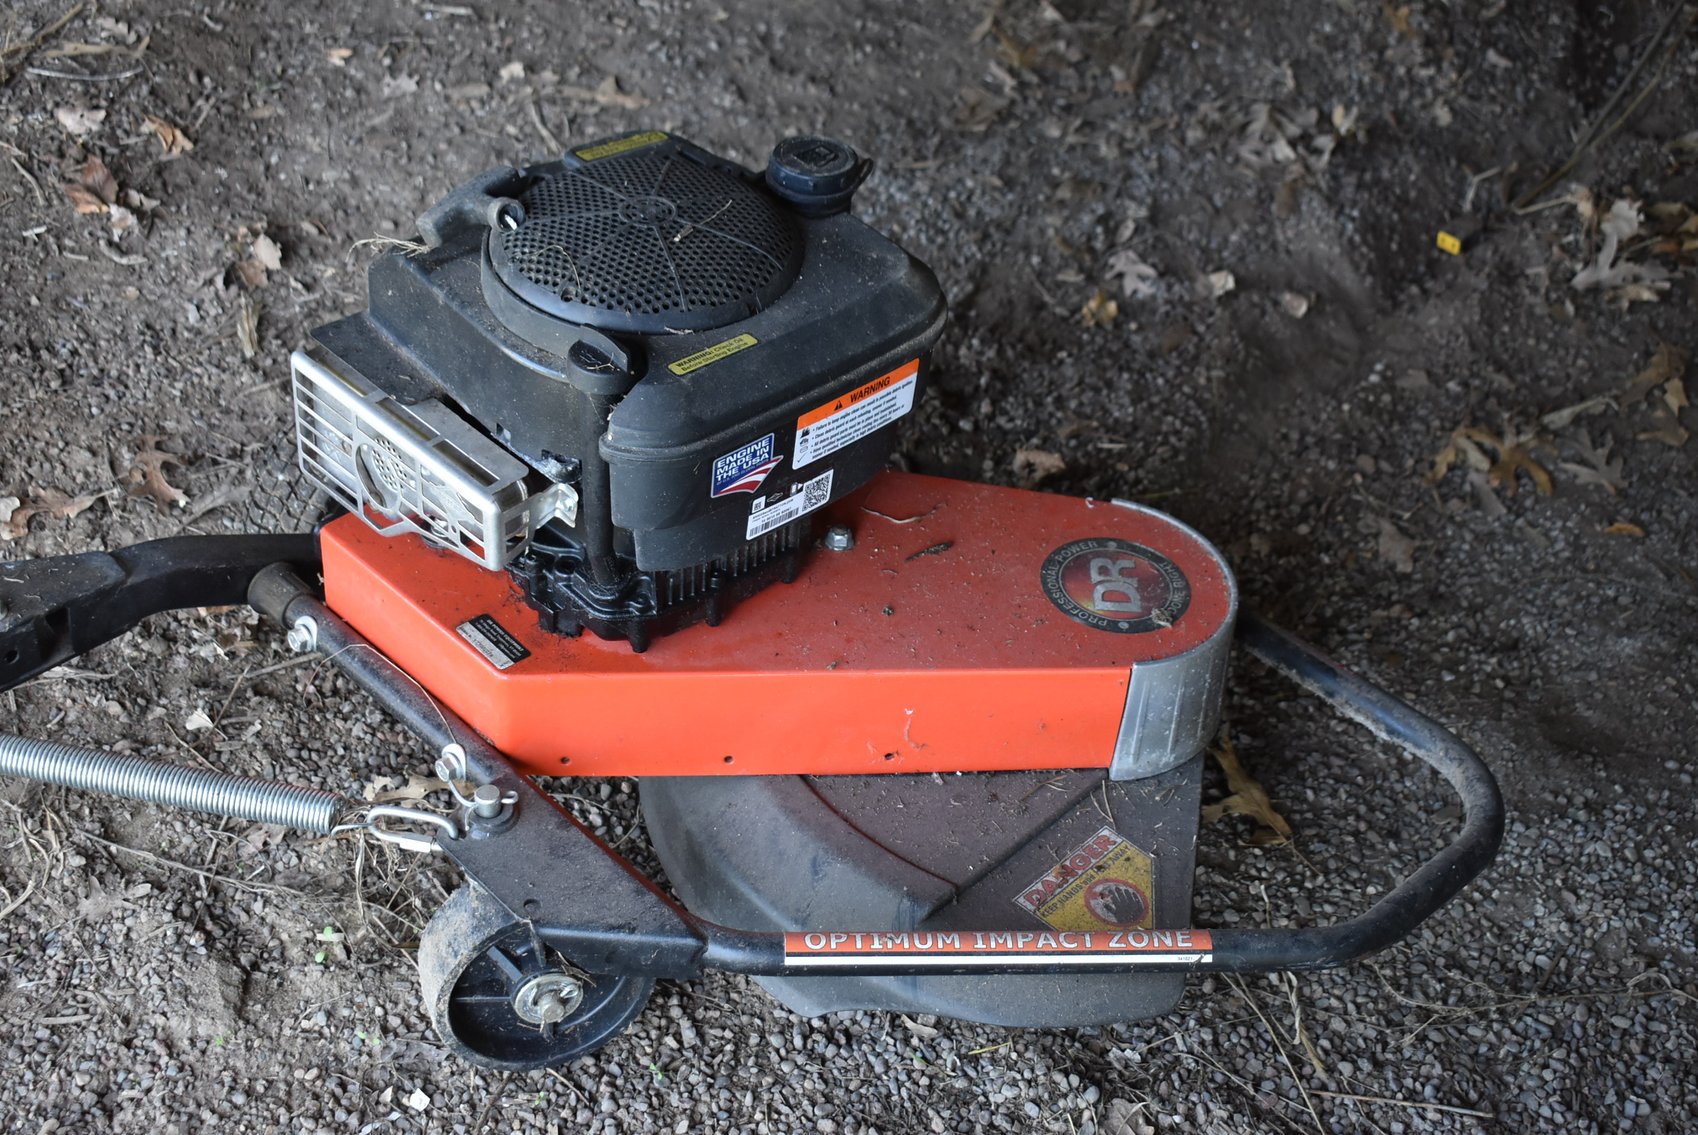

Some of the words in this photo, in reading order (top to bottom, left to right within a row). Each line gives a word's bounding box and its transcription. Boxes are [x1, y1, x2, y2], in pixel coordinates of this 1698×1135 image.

[850, 376, 891, 403] WARNING
[716, 466, 739, 482] THE
[742, 452, 769, 469] USA
[717, 438, 770, 469] ENGINE
[717, 453, 753, 476] MADE
[757, 445, 769, 457] IN
[1055, 540, 1099, 562] POWER
[1090, 557, 1142, 612] DR
[1158, 561, 1187, 588] RIGHT
[1046, 561, 1108, 627] PROFESSIONAL
[1024, 835, 1117, 908] DANGER
[1040, 901, 1059, 918] KEEP
[1057, 882, 1083, 905] HANDS
[804, 932, 961, 950] OPTIMUM
[973, 931, 1095, 949] IMPACT
[1107, 930, 1193, 948] ZONE
